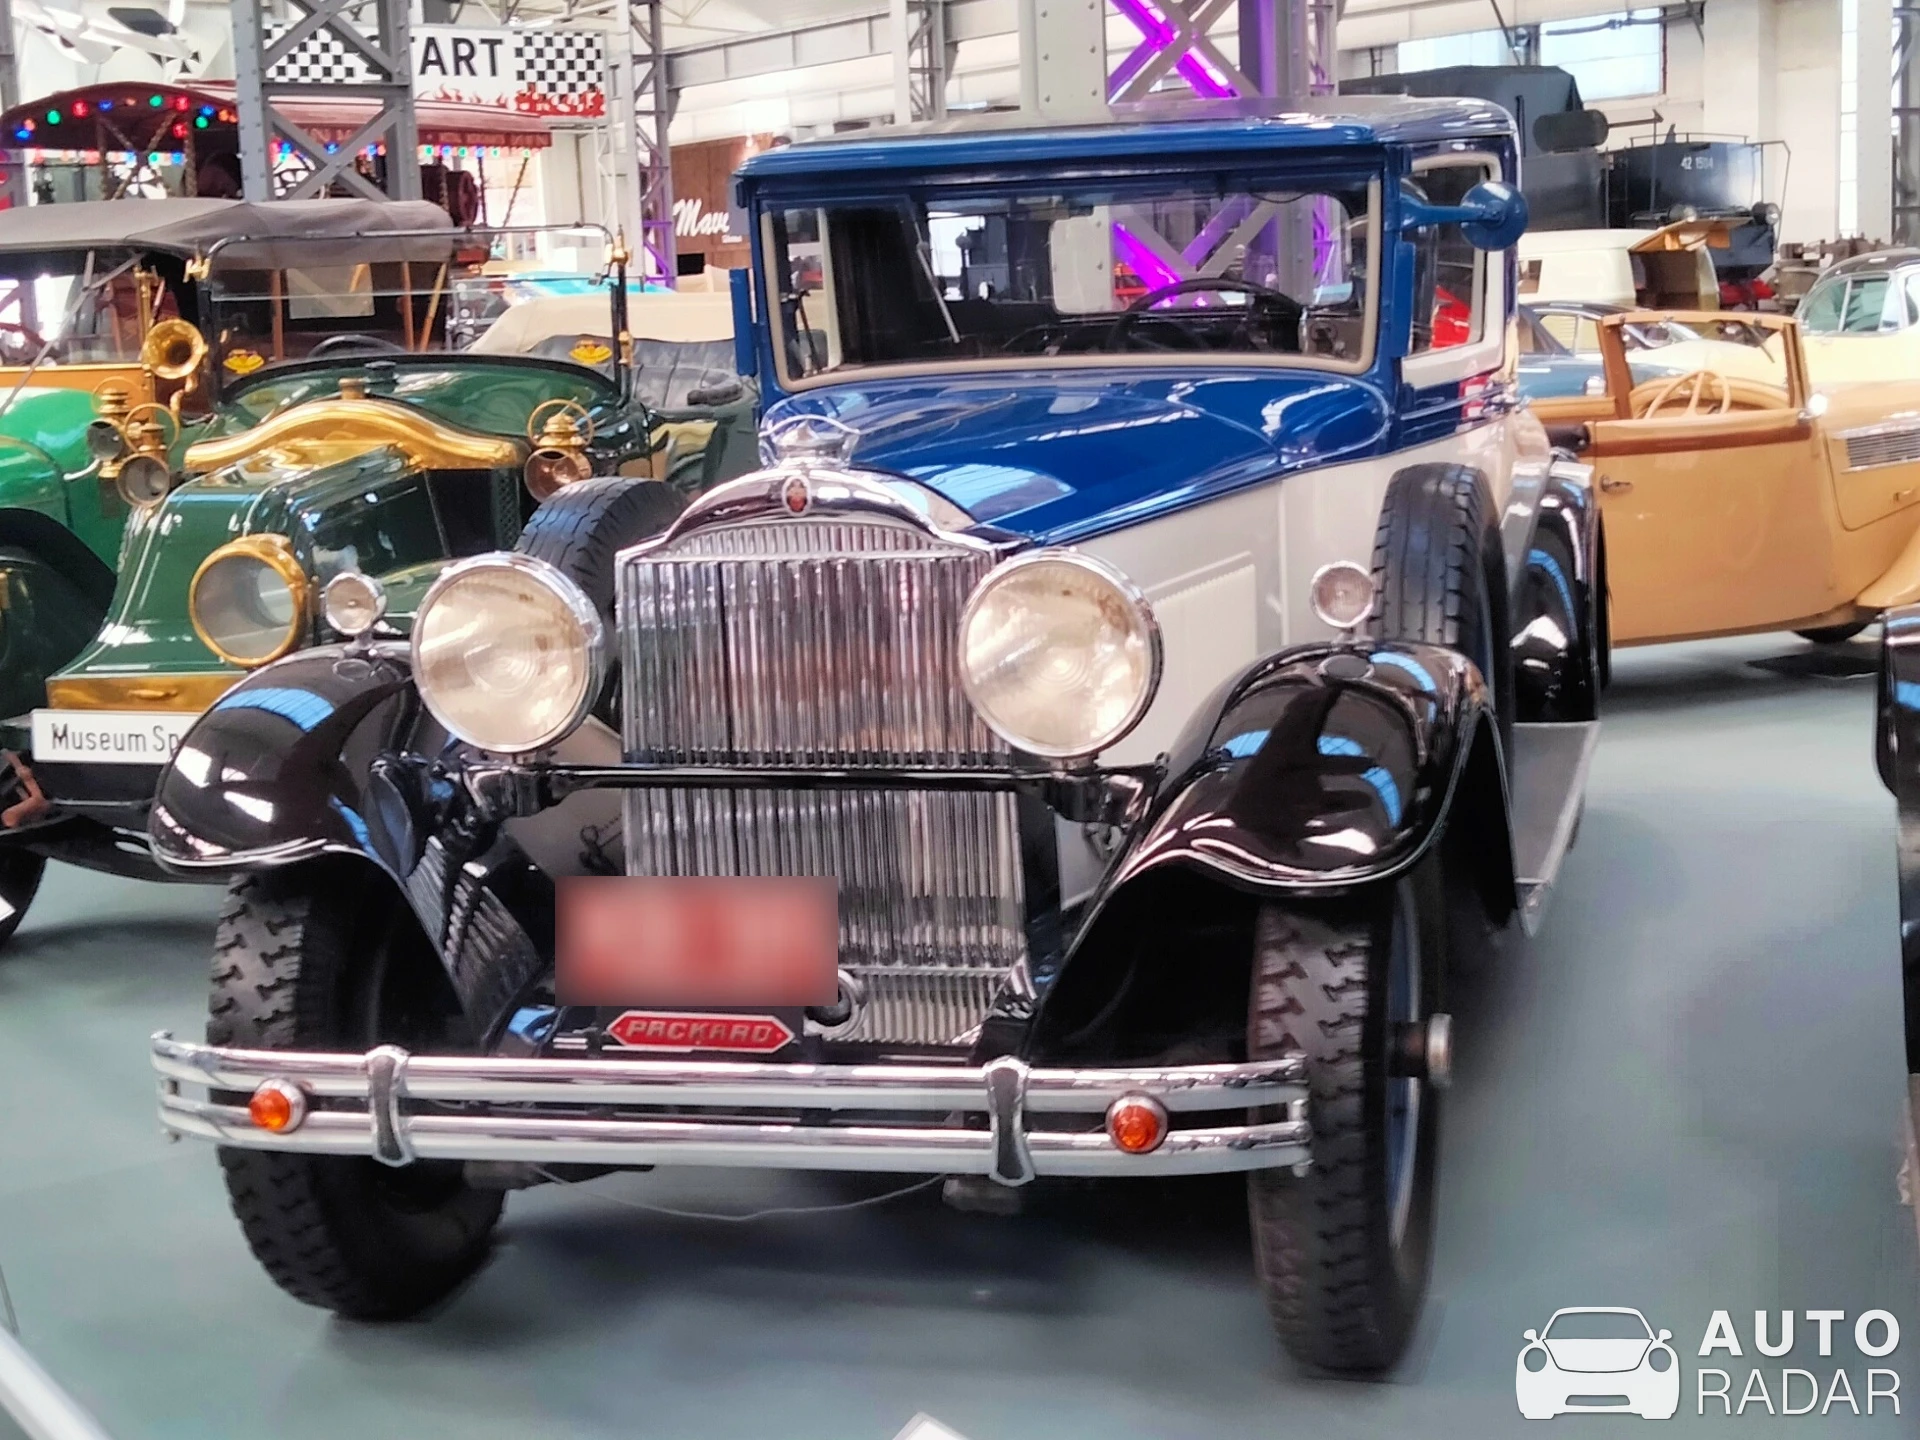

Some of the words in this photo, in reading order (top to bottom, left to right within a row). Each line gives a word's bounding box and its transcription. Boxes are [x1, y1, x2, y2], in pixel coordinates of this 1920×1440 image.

[366, 34, 504, 79] ART
[51, 723, 147, 752] Museum
[625, 1020, 772, 1043] PACKARD
